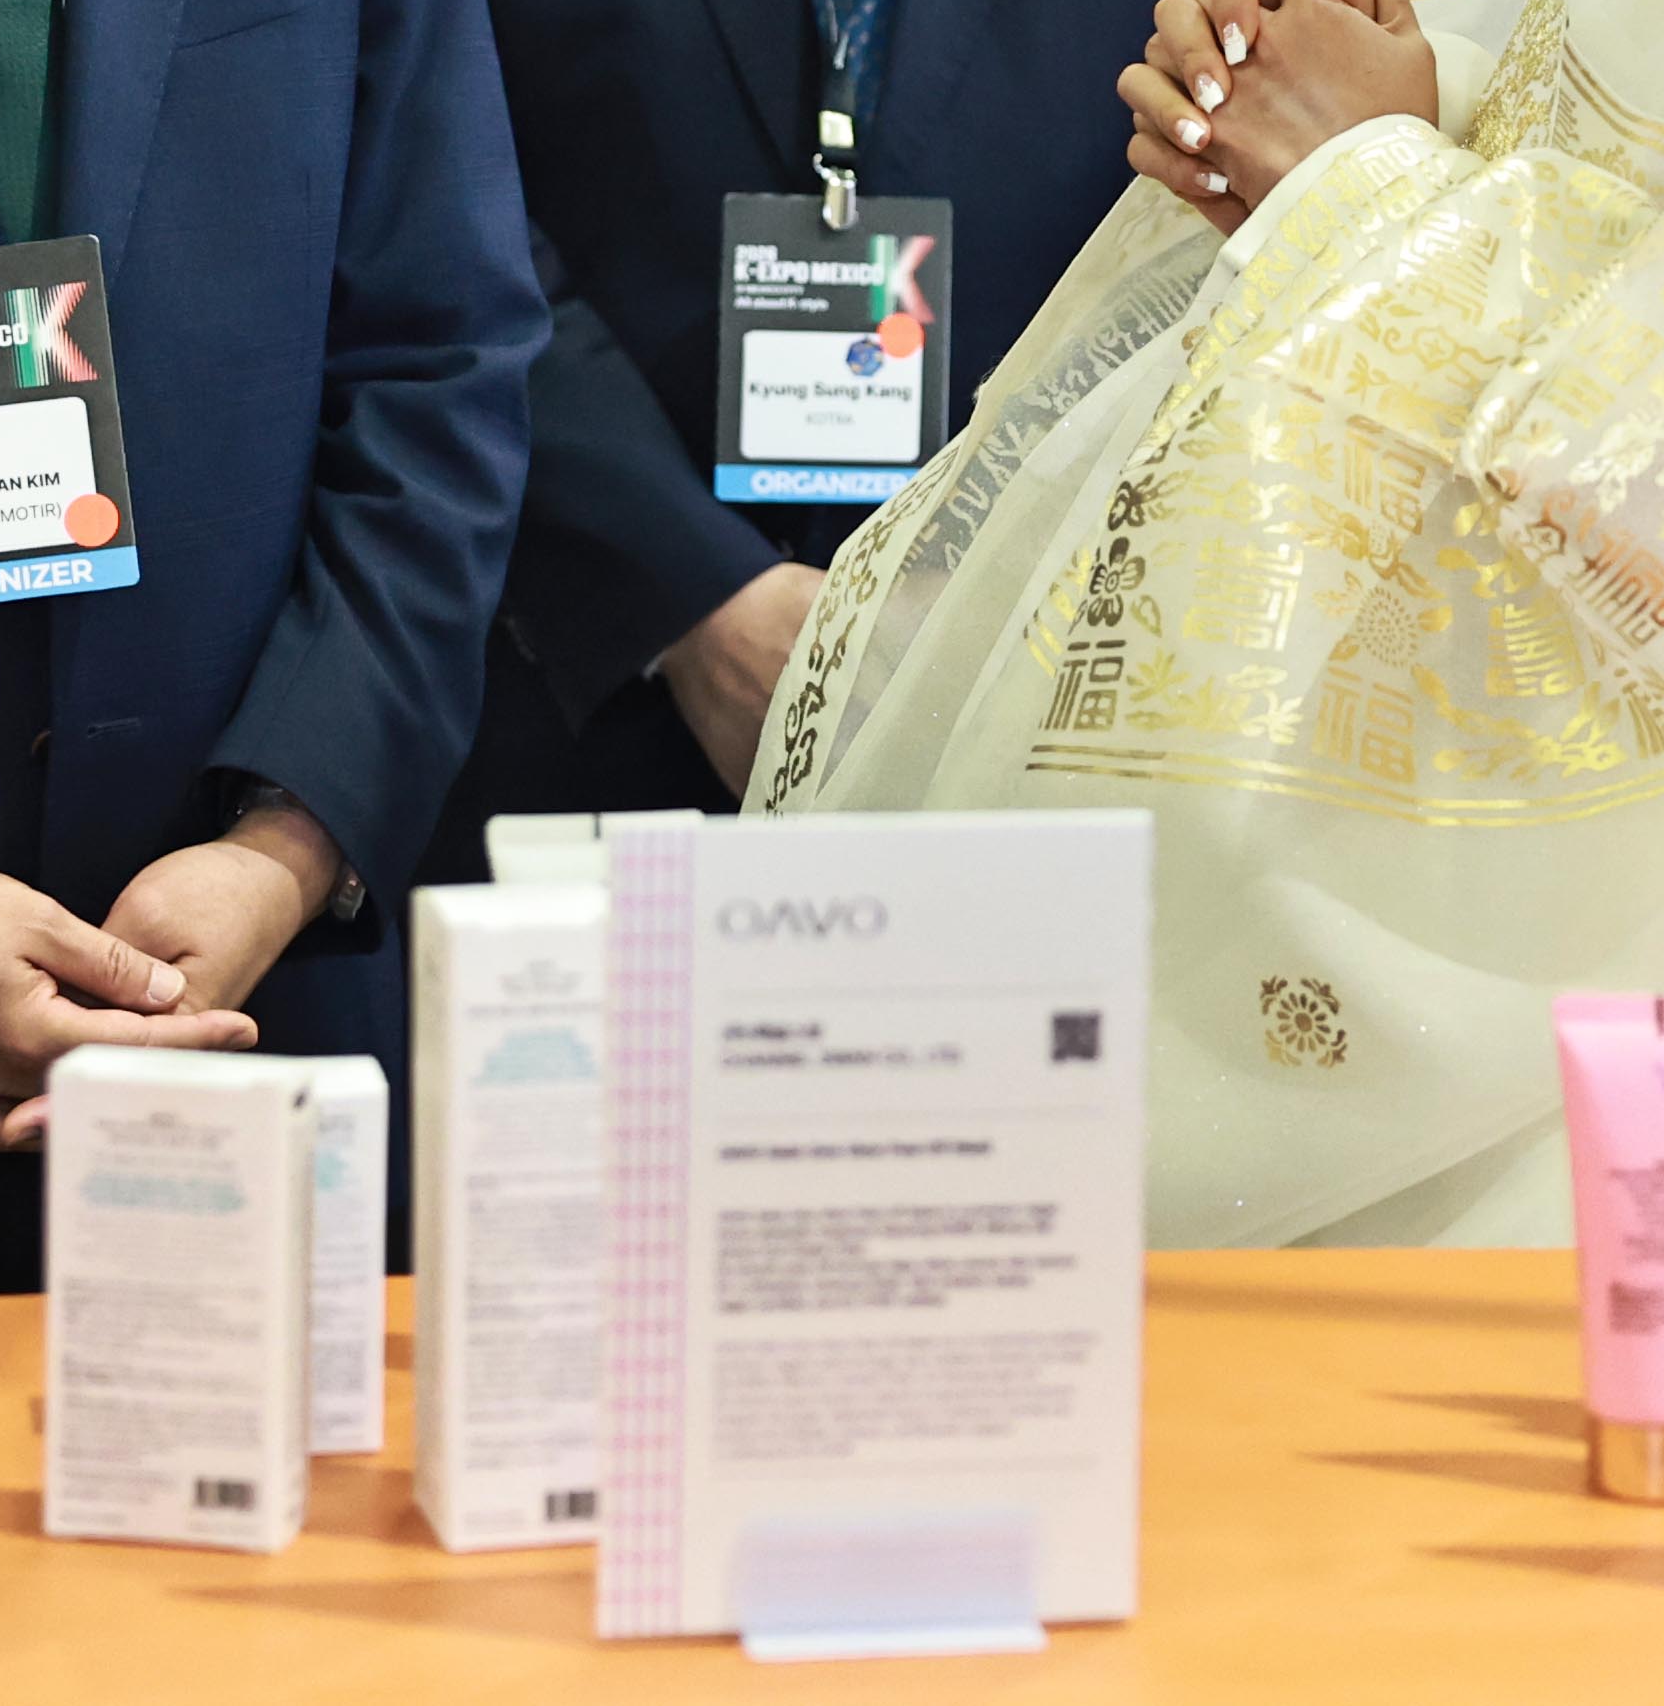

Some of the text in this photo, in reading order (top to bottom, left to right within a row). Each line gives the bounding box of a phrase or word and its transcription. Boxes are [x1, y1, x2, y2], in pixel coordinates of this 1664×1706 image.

[734, 261, 886, 285] K-EXPO MEXICO
[749, 382, 913, 402] Kyung Sung Kang
[26, 471, 61, 489] KIM
[752, 470, 910, 495] ORGANIZER
